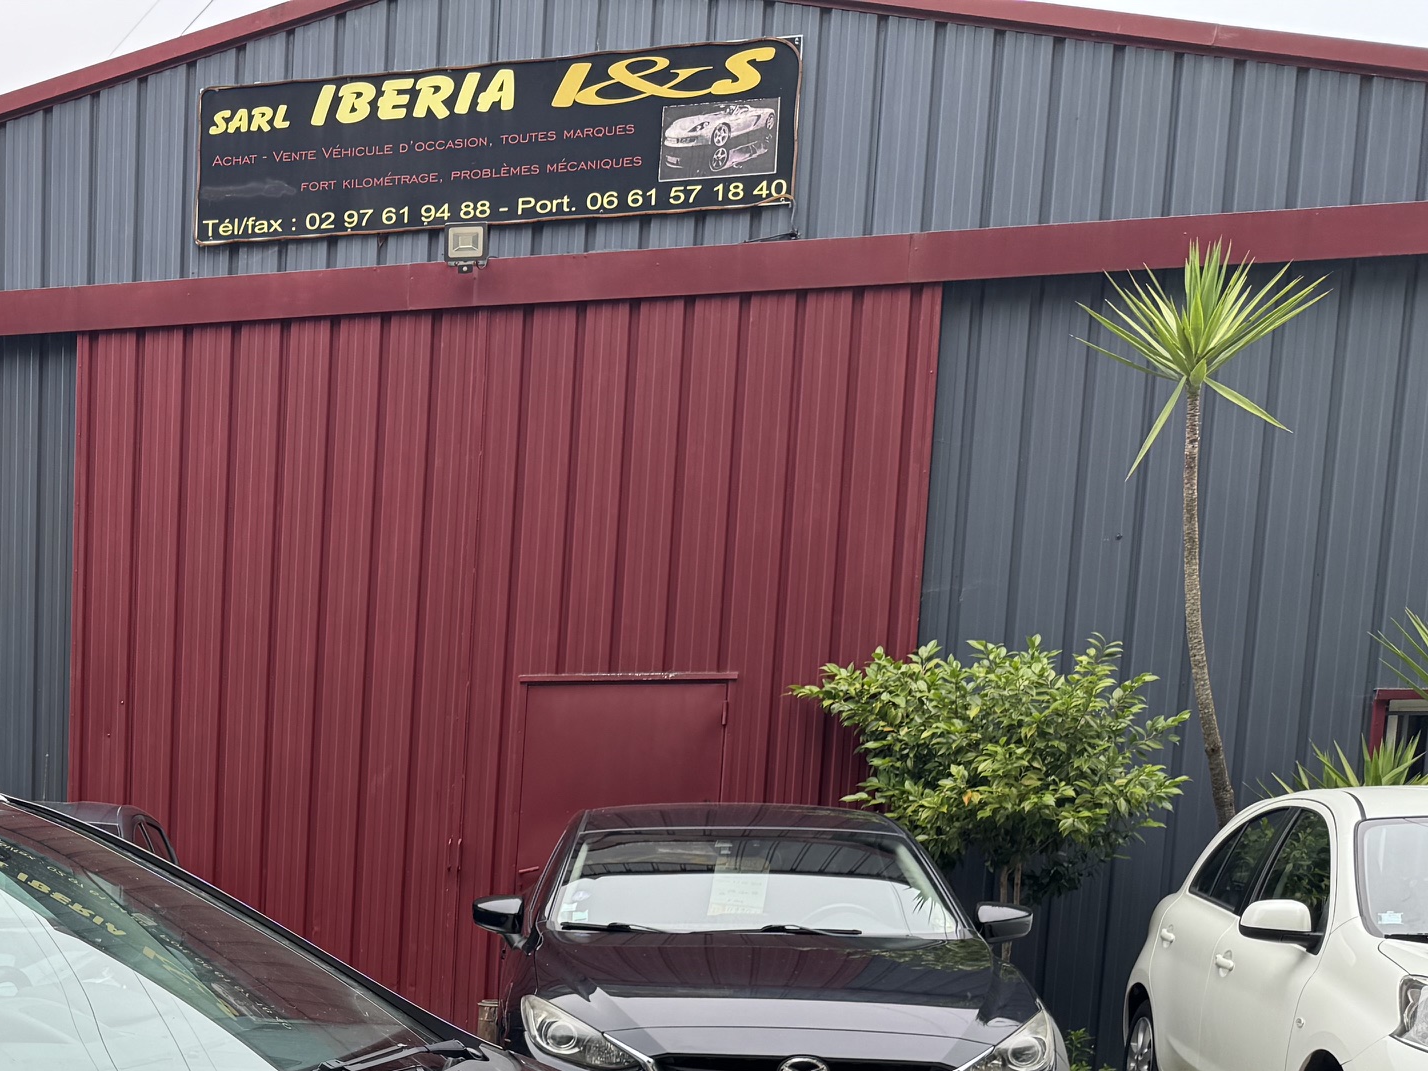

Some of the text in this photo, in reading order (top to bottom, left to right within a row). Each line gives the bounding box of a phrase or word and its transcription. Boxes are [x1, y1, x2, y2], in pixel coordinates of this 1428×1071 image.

[208, 46, 776, 135] SARL IBERIA I&S
[500, 130, 557, 145] TOUTES
[563, 124, 635, 140] MARQUES
[300, 155, 643, 192] FORT KILOMÉTRAGE, PROBLÈMES MÉCANIQUES
[203, 215, 283, 238] Tél/fax
[305, 211, 335, 230] 02
[344, 208, 374, 228] 97
[381, 205, 409, 225] 61
[420, 202, 451, 223] 94
[459, 200, 491, 219] 88
[517, 195, 576, 215] Port.
[586, 190, 618, 211] 06
[627, 187, 657, 207] 61
[669, 184, 702, 205] 57
[713, 182, 744, 202] 18
[752, 178, 788, 198] 40
